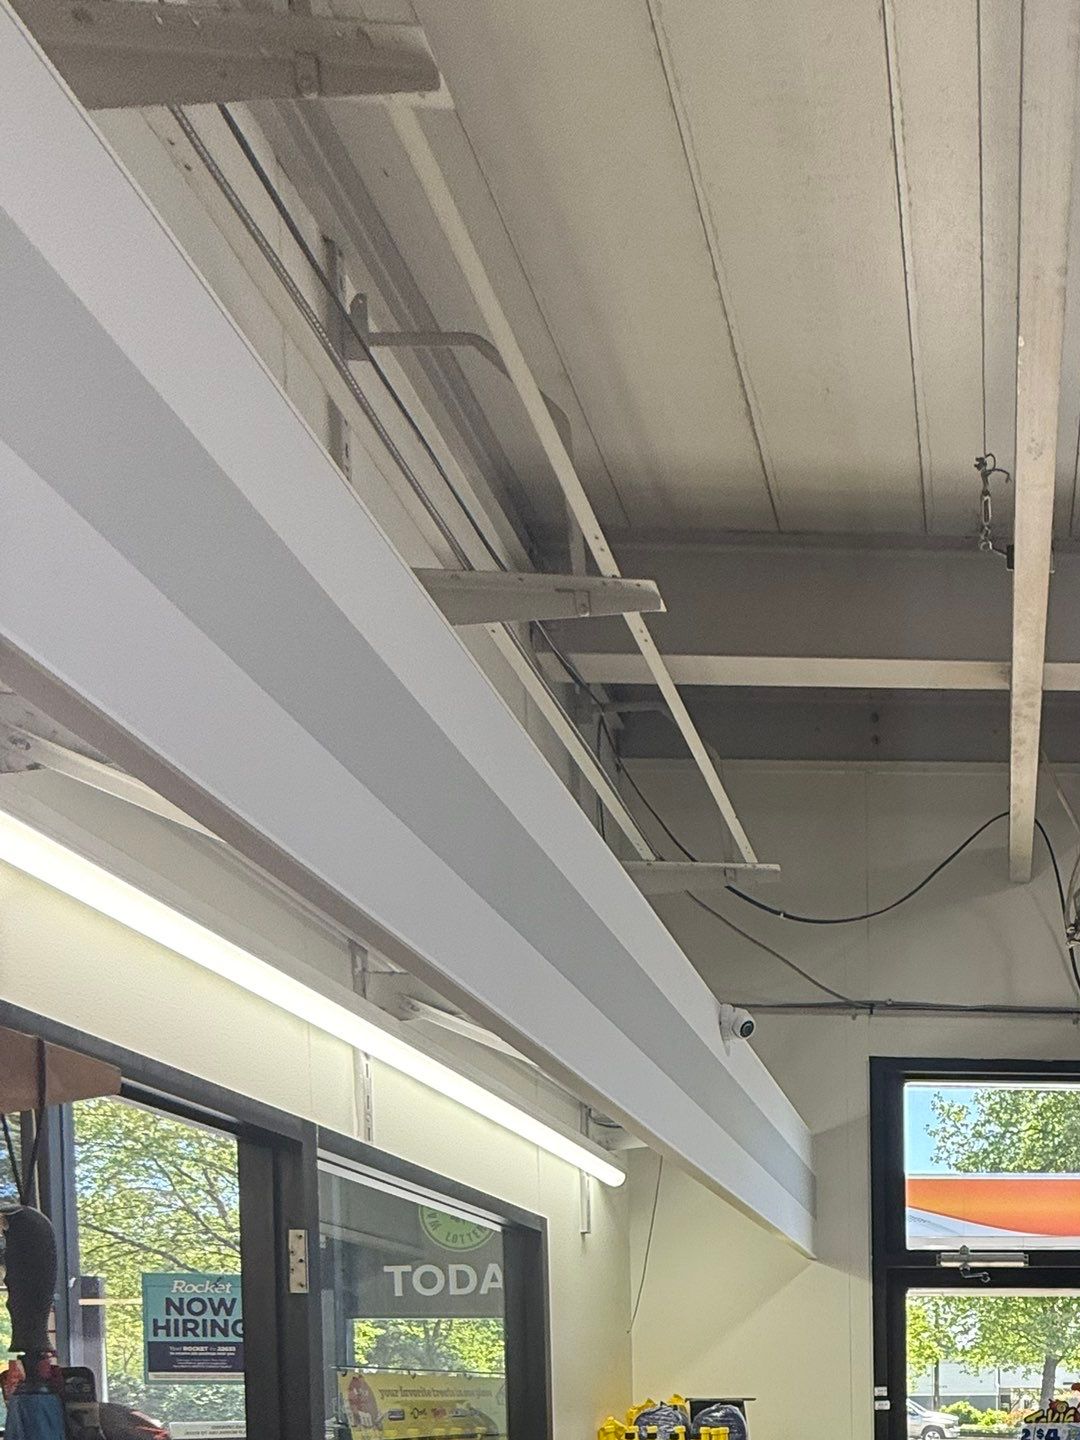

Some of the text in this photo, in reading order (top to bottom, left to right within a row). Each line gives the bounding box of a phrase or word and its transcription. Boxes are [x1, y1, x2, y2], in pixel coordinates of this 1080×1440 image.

[171, 1280, 232, 1294] Rocket
[383, 1263, 503, 1297] TODA
[165, 1297, 237, 1316] NOW
